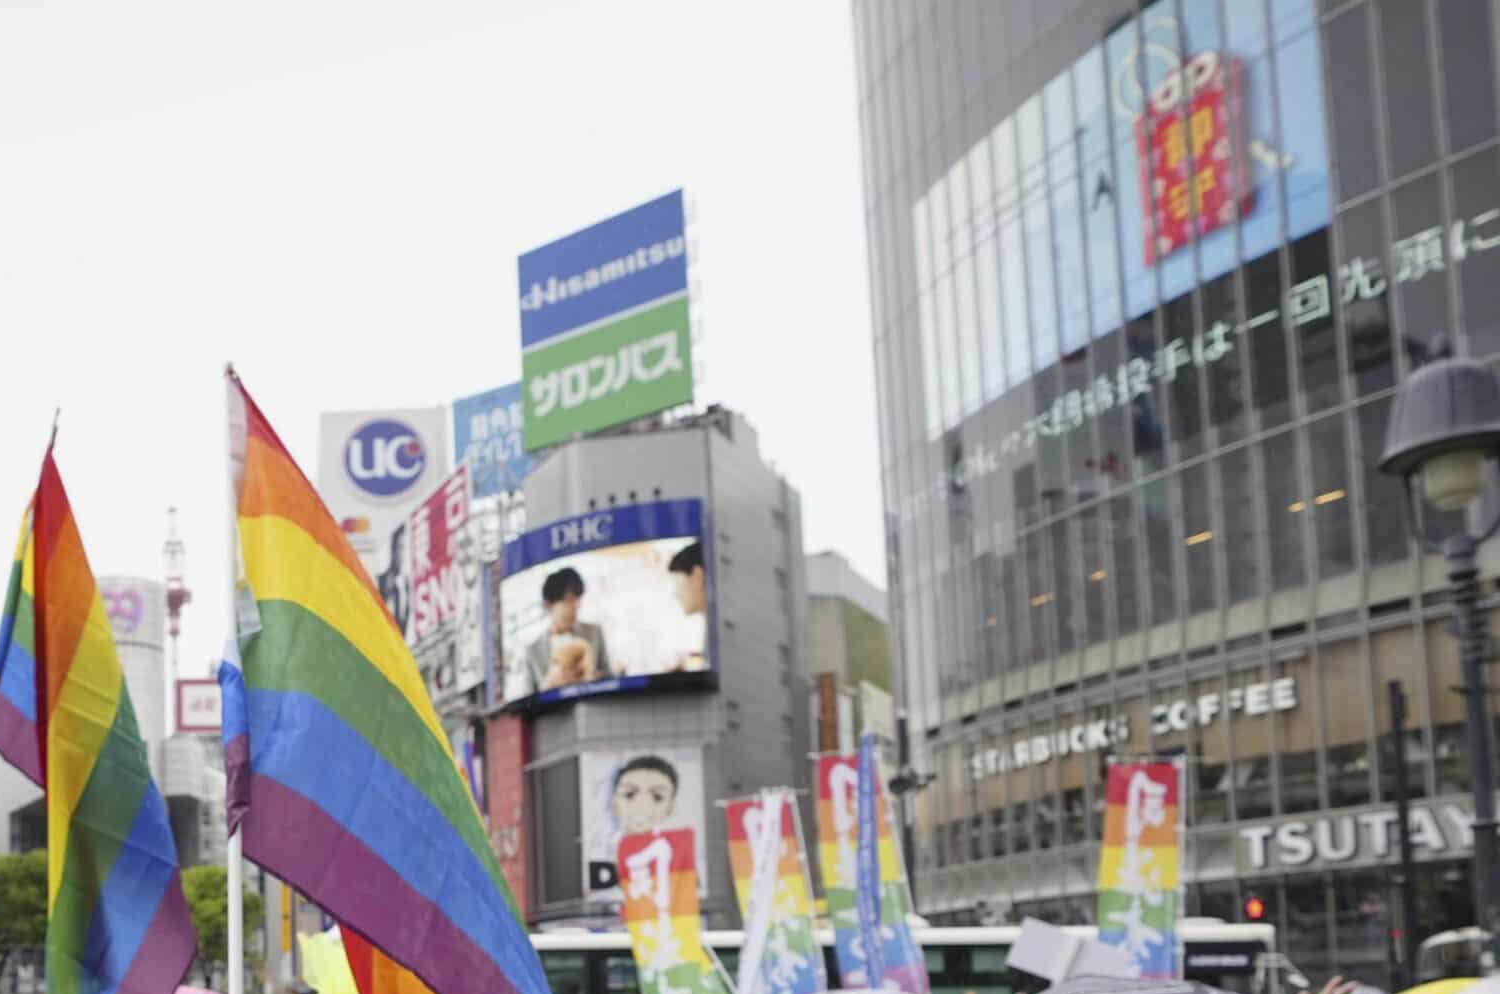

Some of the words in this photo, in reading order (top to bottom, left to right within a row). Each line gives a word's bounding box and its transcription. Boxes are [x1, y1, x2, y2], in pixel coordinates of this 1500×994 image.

[521, 235, 685, 311] Hisamitsu
[529, 330, 682, 417] サロンパス
[349, 434, 421, 480] UC
[551, 513, 614, 550] DHC
[972, 714, 1130, 780] STARBUCKS
[1239, 800, 1500, 868] TSUTAY
